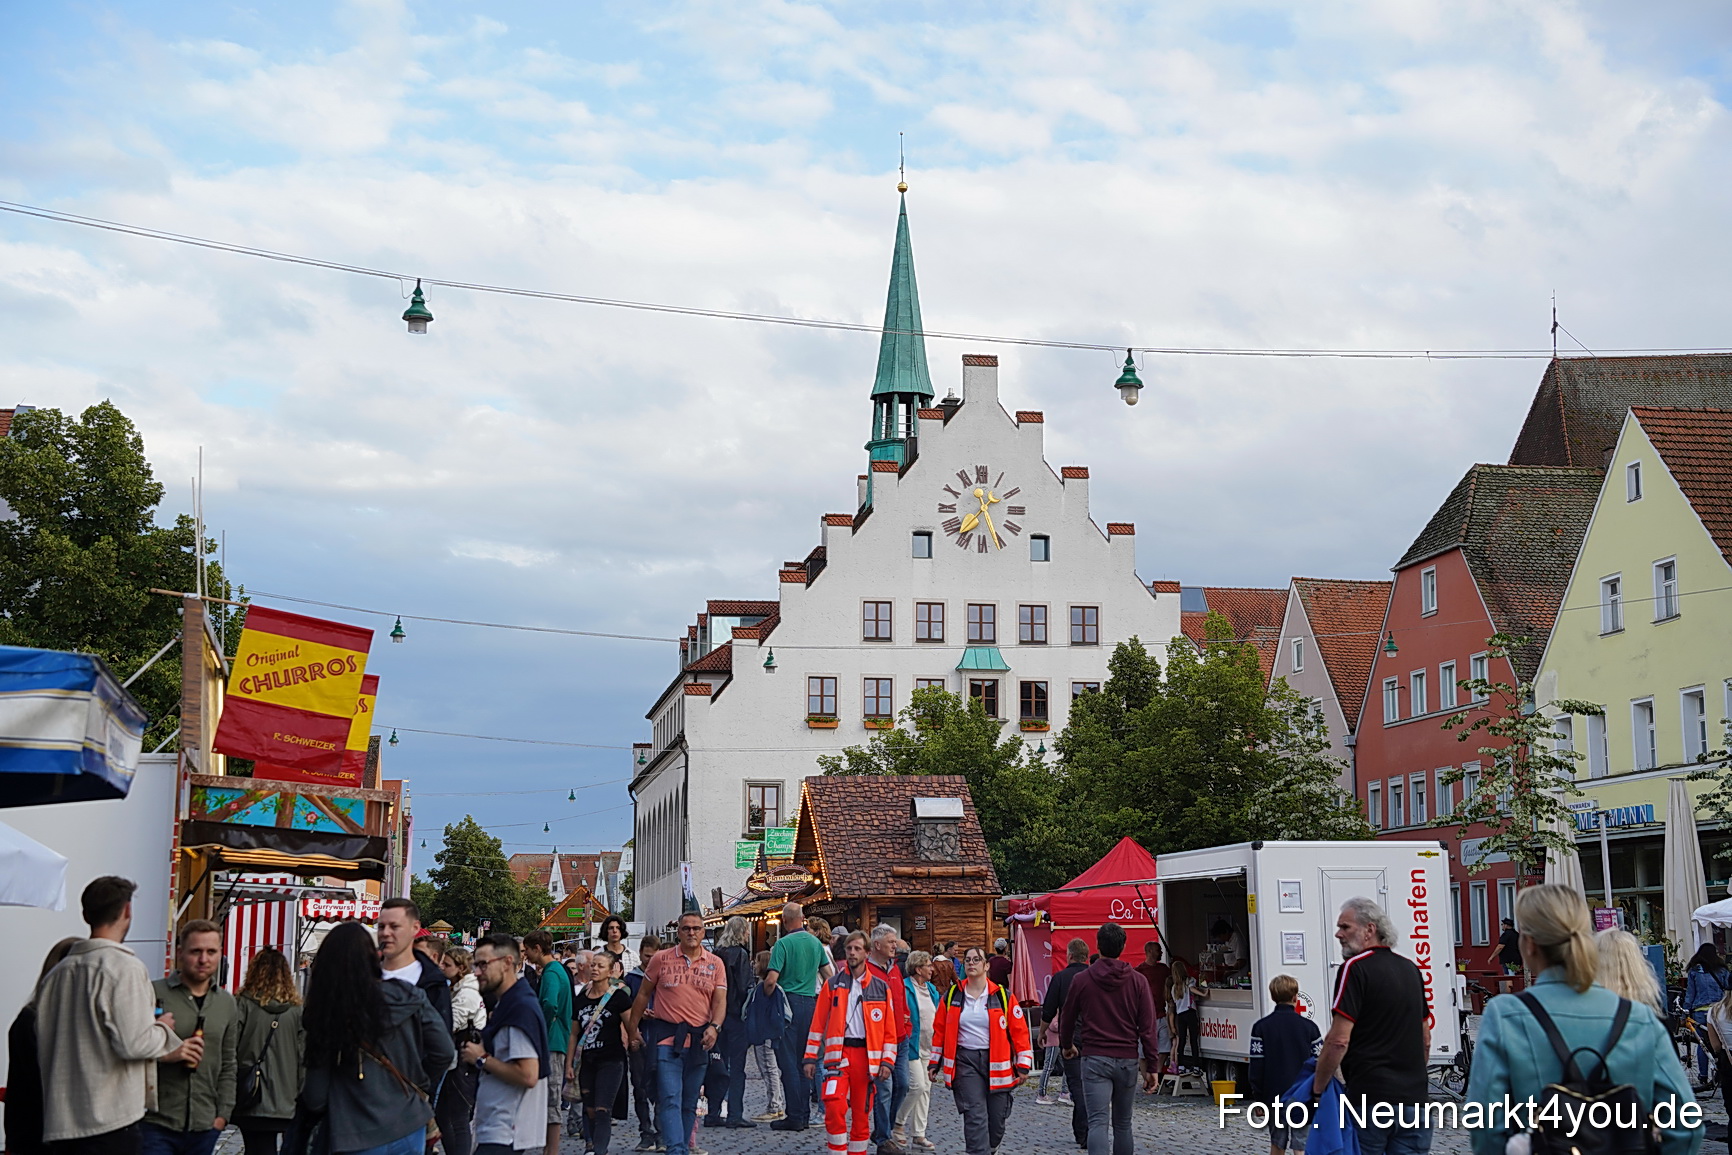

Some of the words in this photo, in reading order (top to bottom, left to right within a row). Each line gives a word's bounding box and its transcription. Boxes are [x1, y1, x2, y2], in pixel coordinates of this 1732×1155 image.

[246, 645, 300, 668] Original
[239, 655, 358, 695] CHURROS
[283, 734, 336, 752] SCHWEIZER
[312, 903, 354, 911] Currywurst
[1108, 899, 1134, 920] La
[1200, 1017, 1238, 1040] ückshafen
